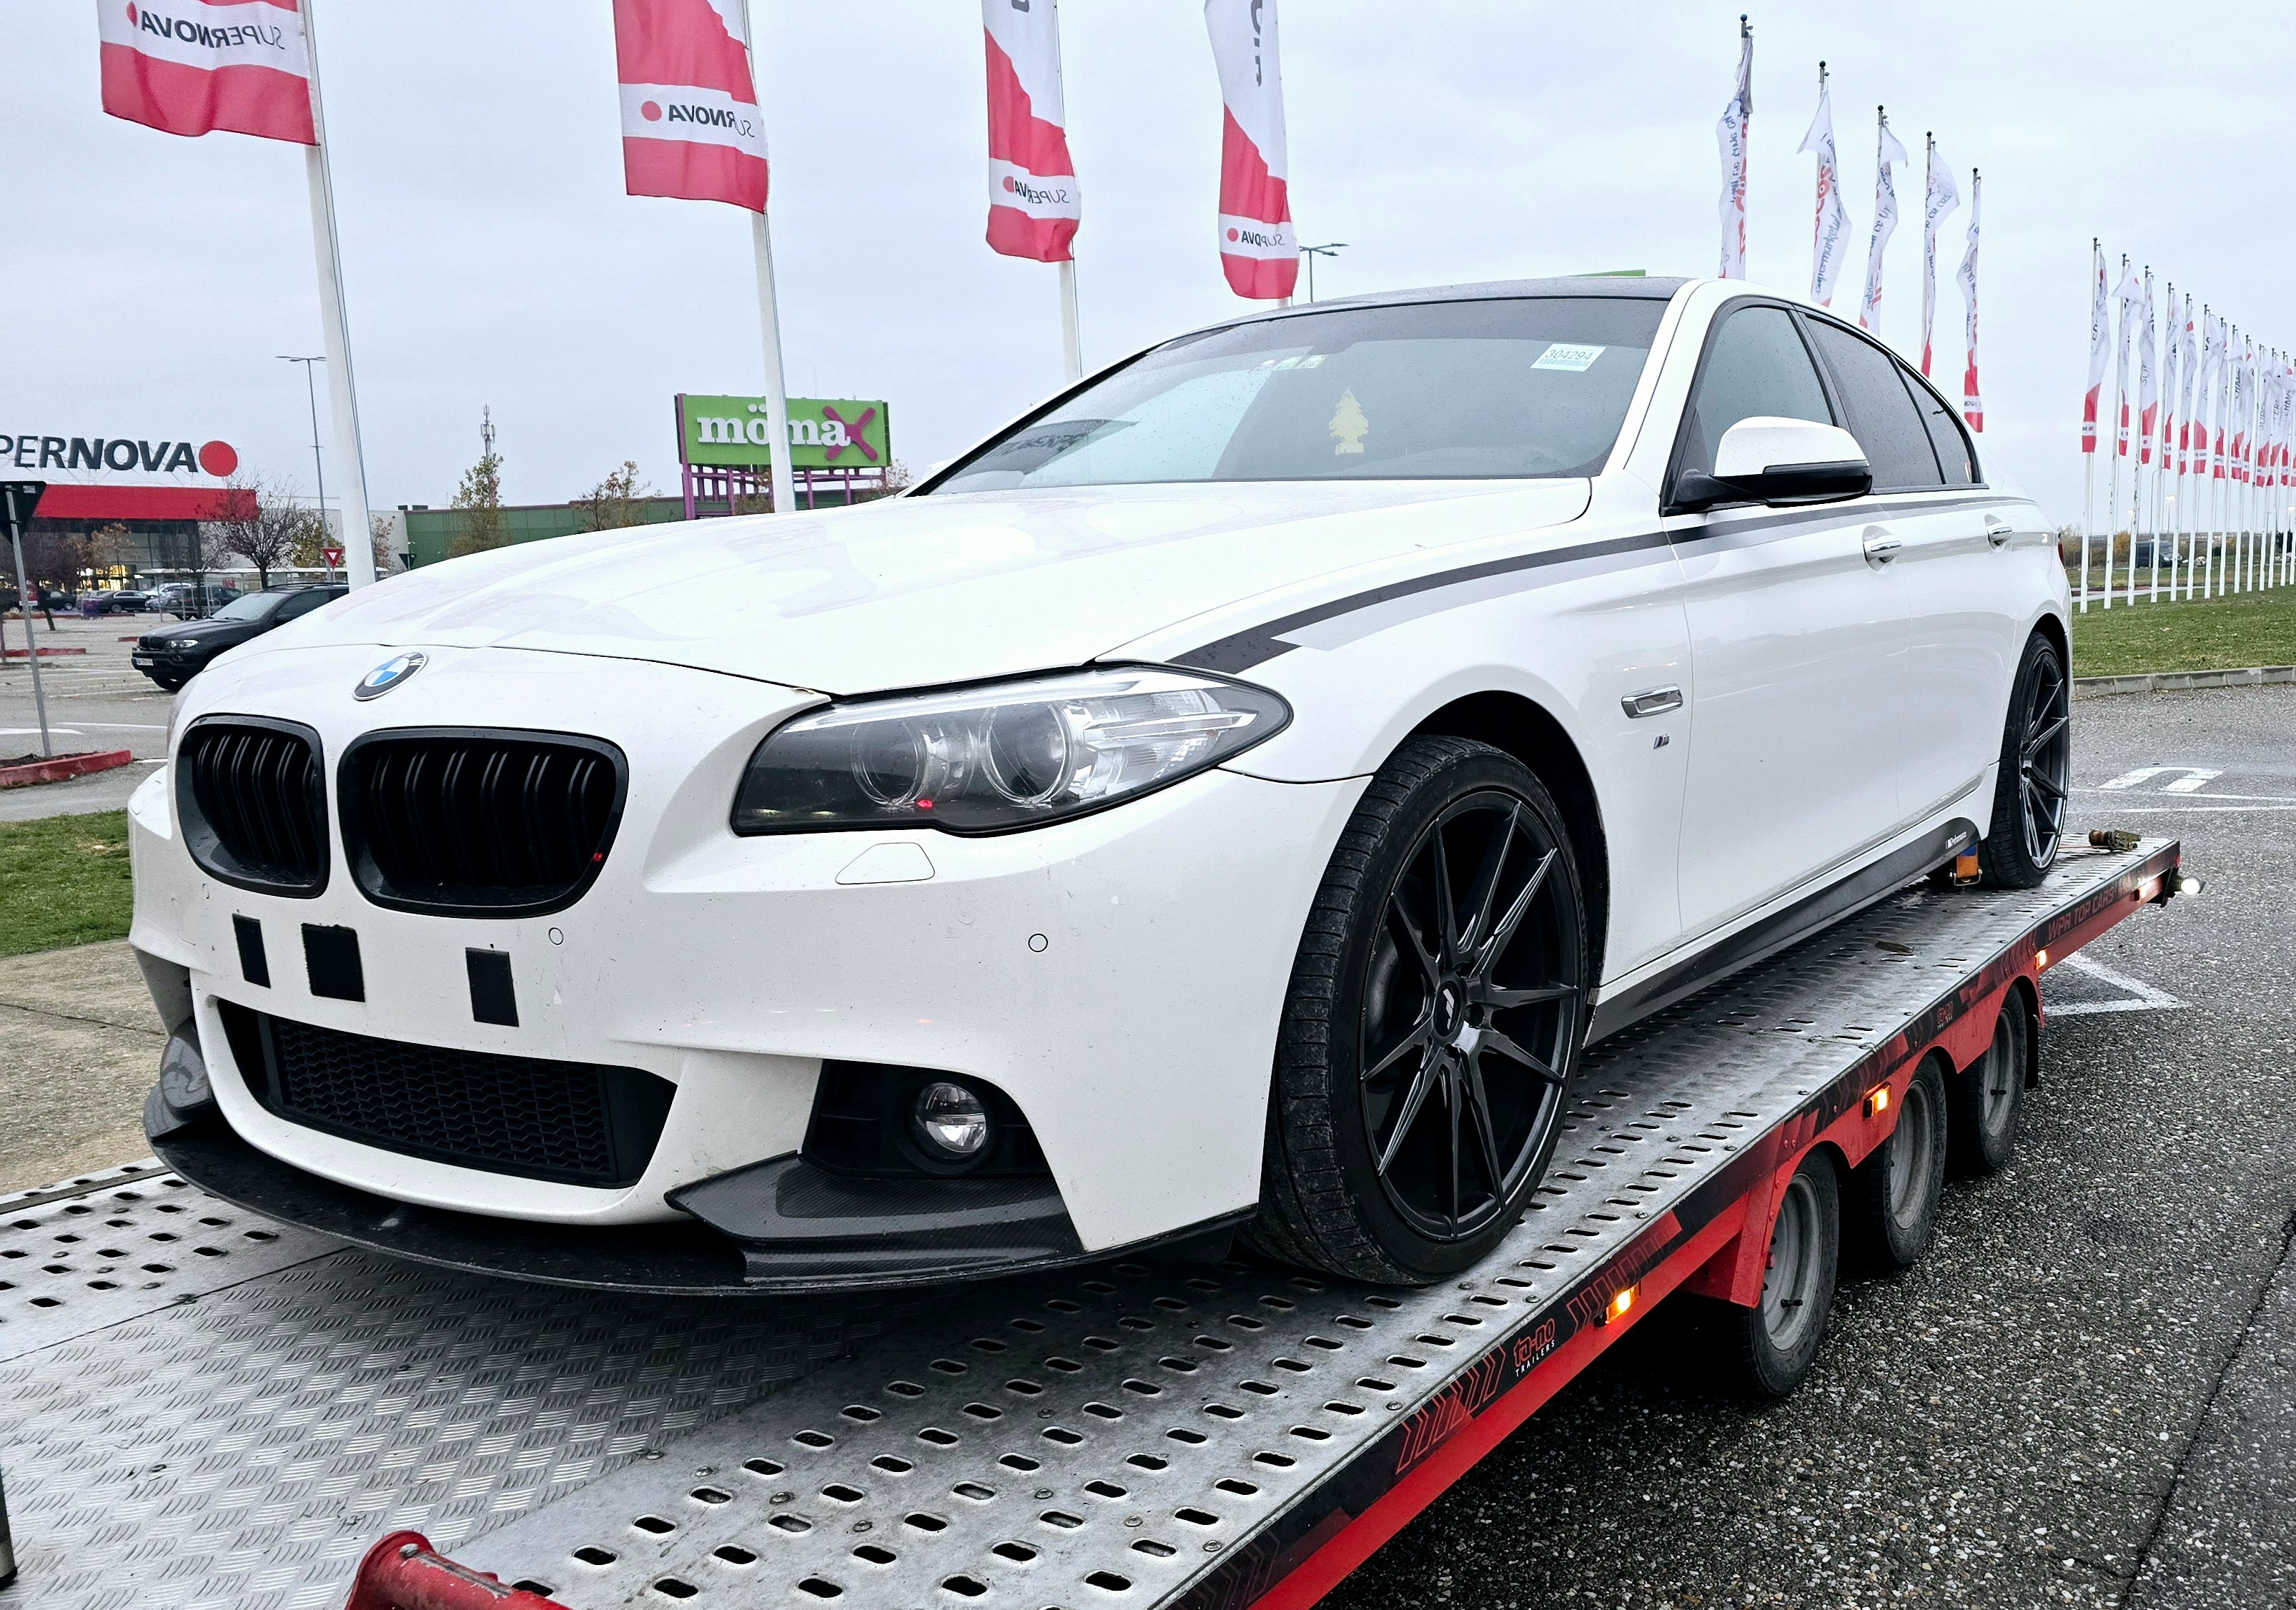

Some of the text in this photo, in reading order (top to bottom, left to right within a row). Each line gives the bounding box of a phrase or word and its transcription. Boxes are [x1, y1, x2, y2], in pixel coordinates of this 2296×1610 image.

[1545, 349, 1594, 361] 304294
[2074, 902, 2091, 924] TOP
[2092, 886, 2115, 914] CARS
[1515, 1339, 1555, 1378] TRAILERS
